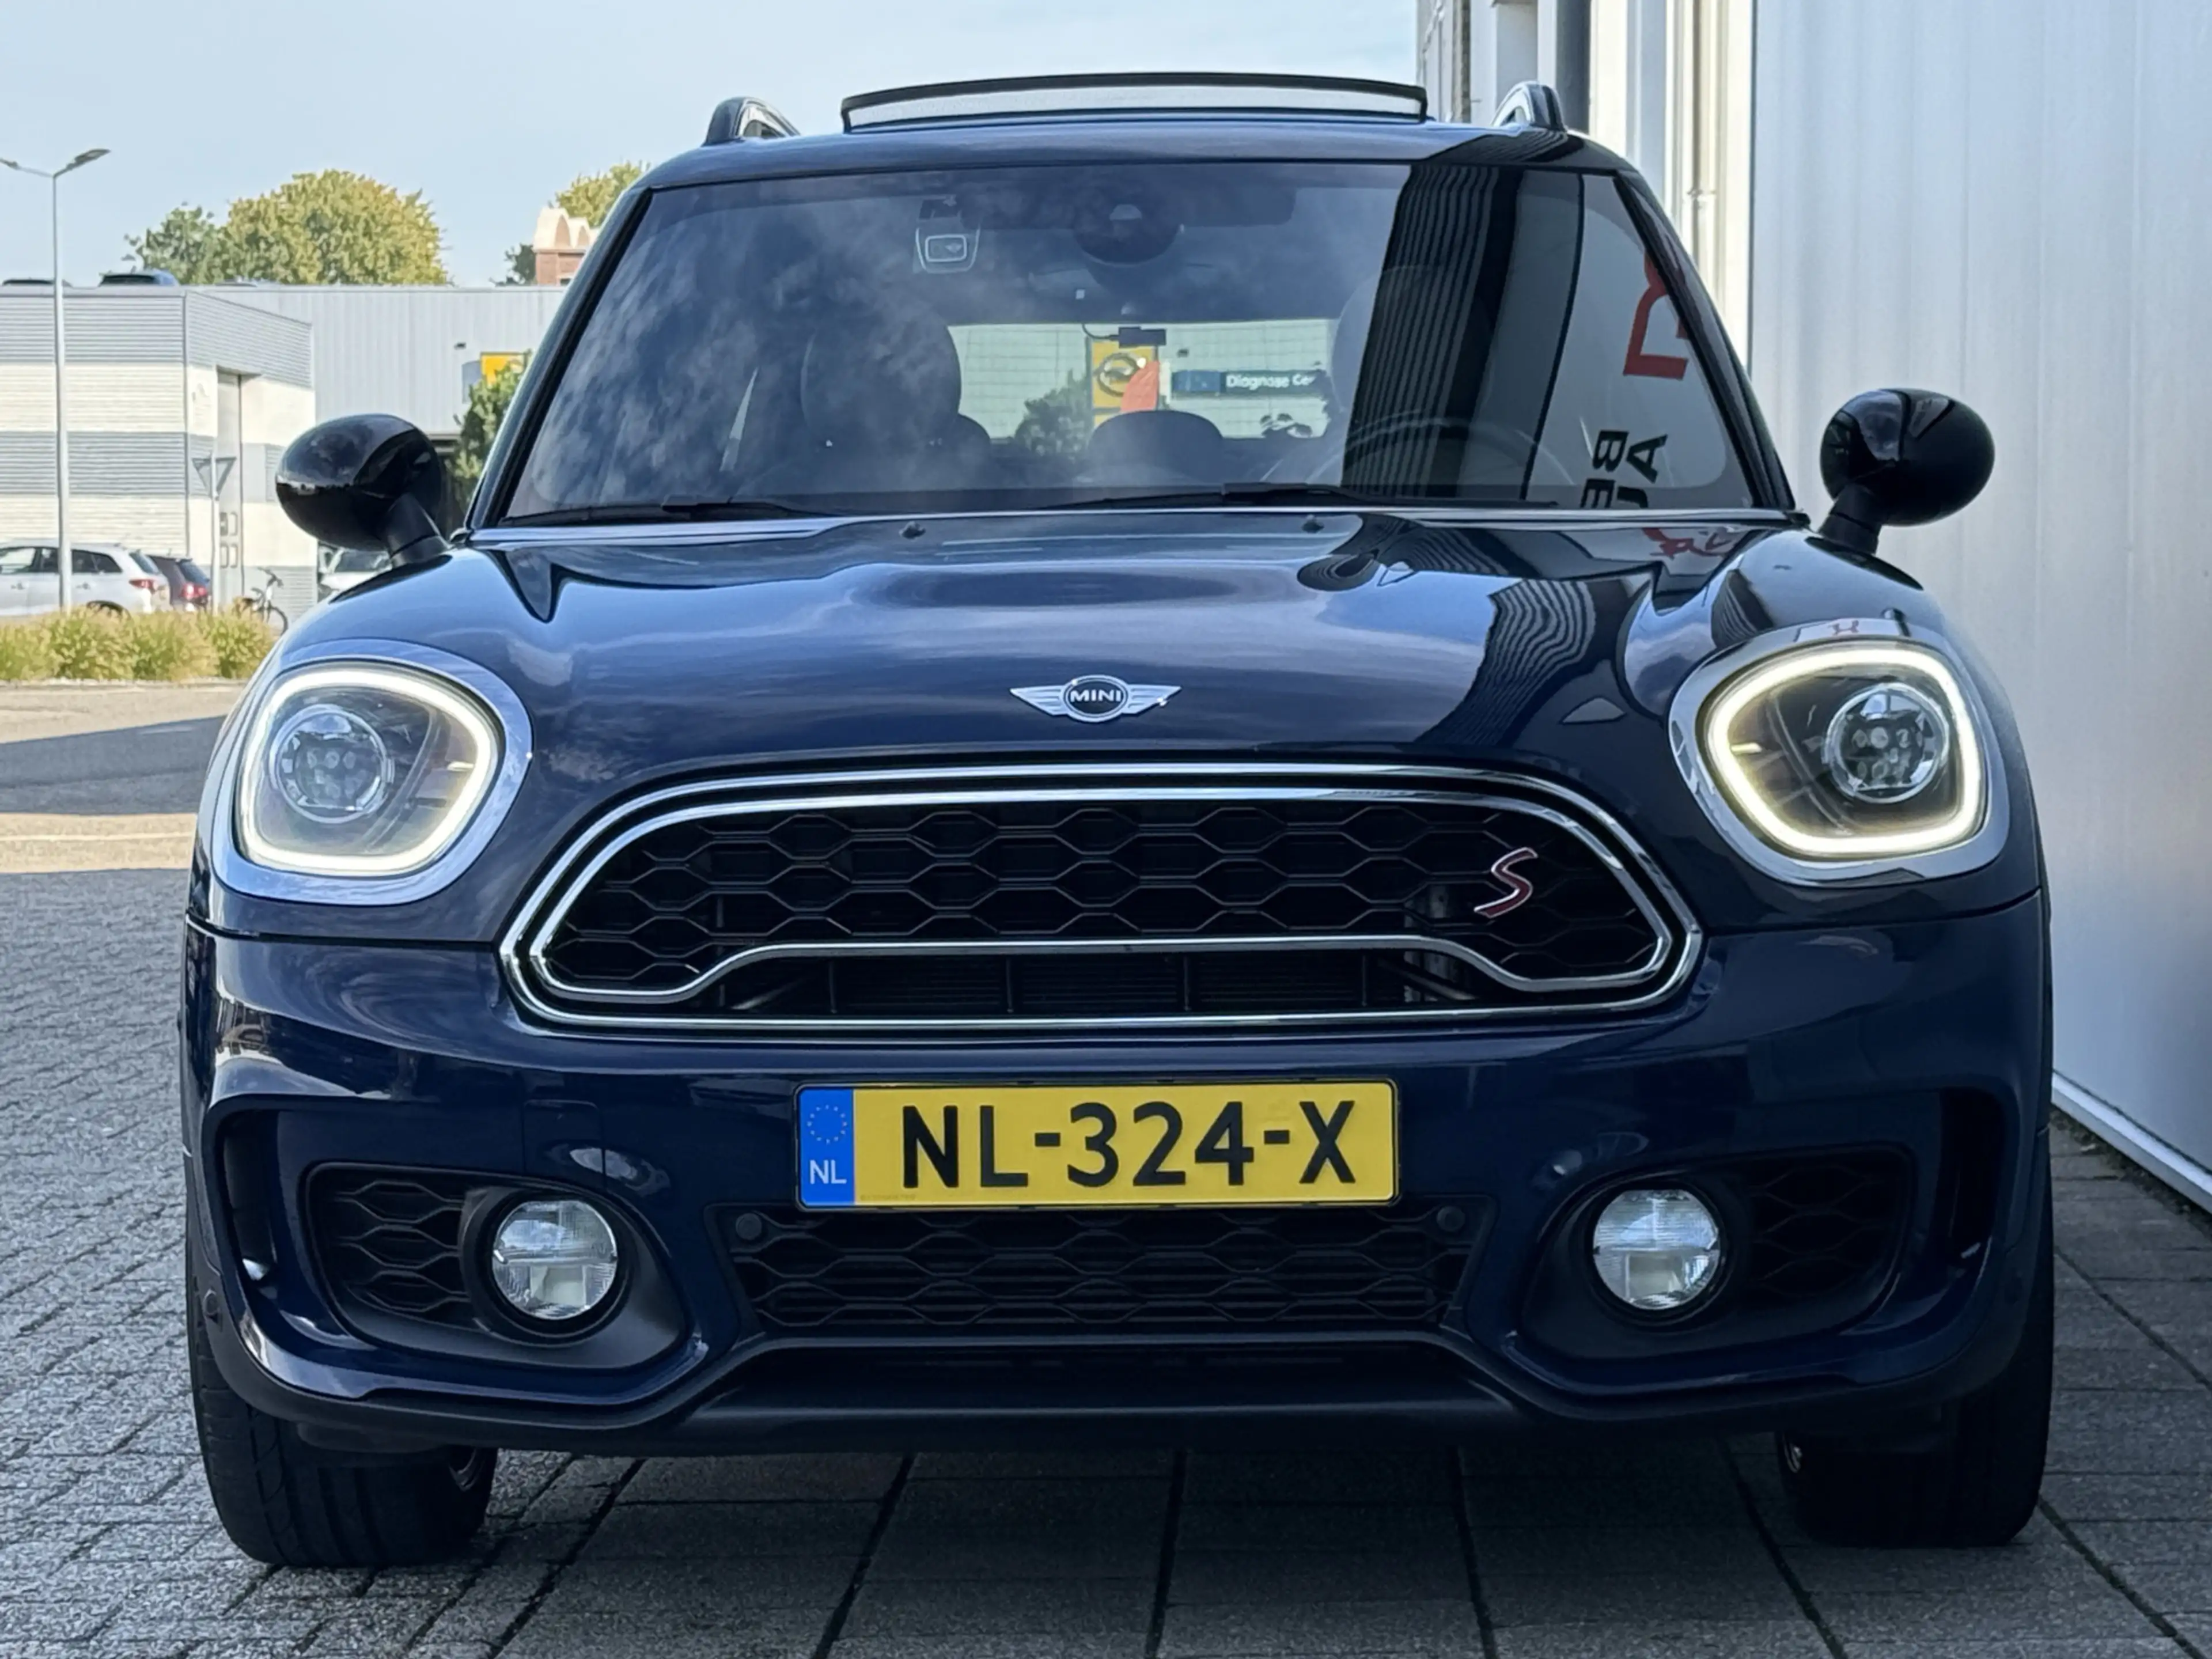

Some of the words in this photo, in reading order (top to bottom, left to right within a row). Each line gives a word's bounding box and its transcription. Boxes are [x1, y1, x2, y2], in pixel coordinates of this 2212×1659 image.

[1225, 374, 1289, 390] Diagnose
[1070, 689, 1122, 703] MINI
[1474, 846, 1539, 918] S
[902, 1100, 1356, 1188] NL-324-X
[809, 1159, 848, 1184] NL
